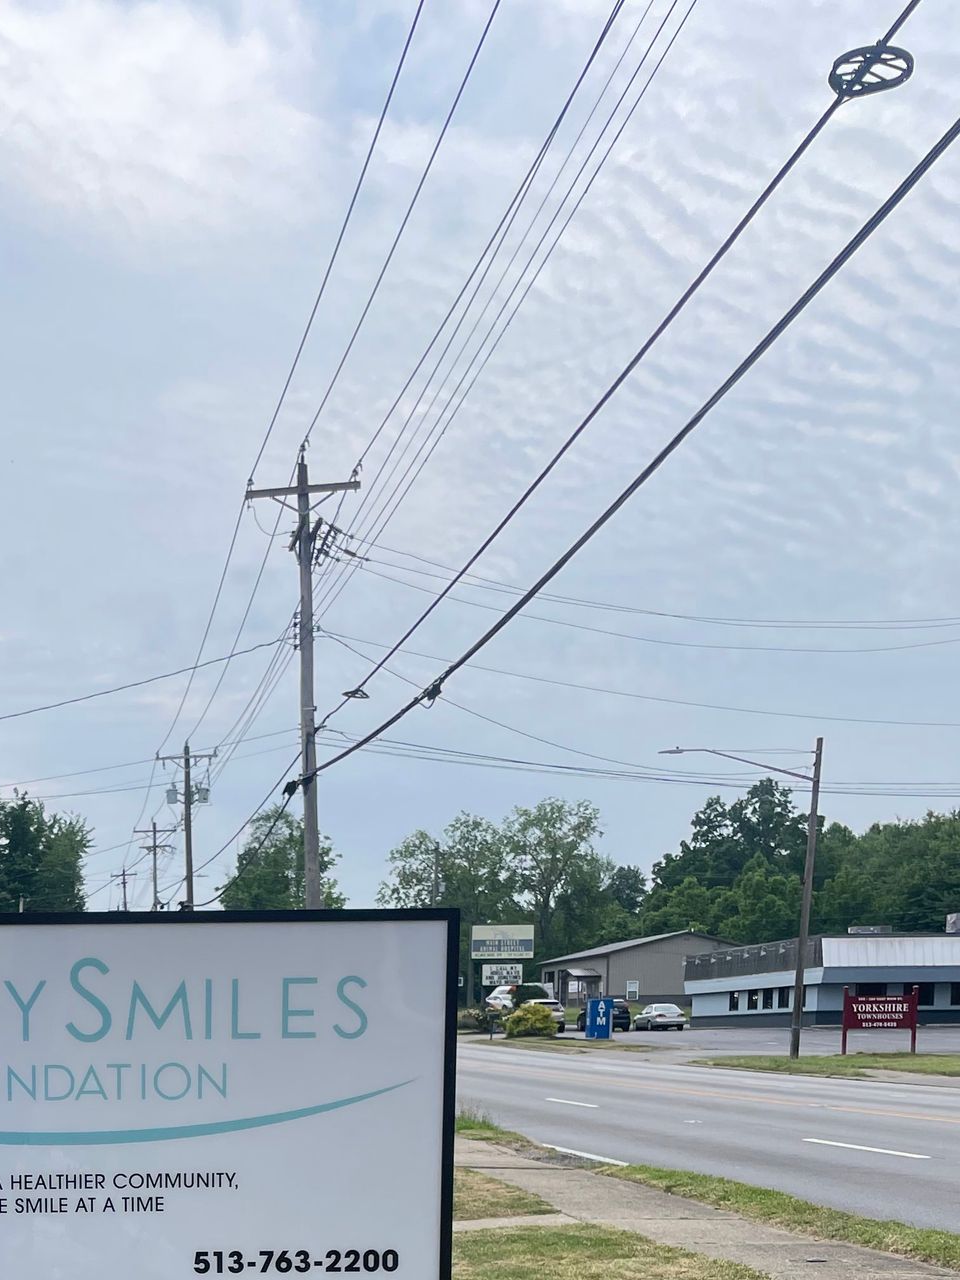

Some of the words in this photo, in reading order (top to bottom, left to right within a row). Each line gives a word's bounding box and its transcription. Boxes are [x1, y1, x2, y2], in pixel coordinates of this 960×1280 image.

[596, 1000, 606, 1026] ATM
[852, 1003, 909, 1012] YORKSHIRE
[10, 1173, 106, 1191] HEALTHIER
[112, 1172, 239, 1190] COMMUNITY,
[14, 1197, 69, 1214] SMILE
[75, 1197, 97, 1213] AT
[103, 1197, 116, 1213] A
[122, 1196, 165, 1213] TIME
[193, 1248, 400, 1275] 513-763-2200
